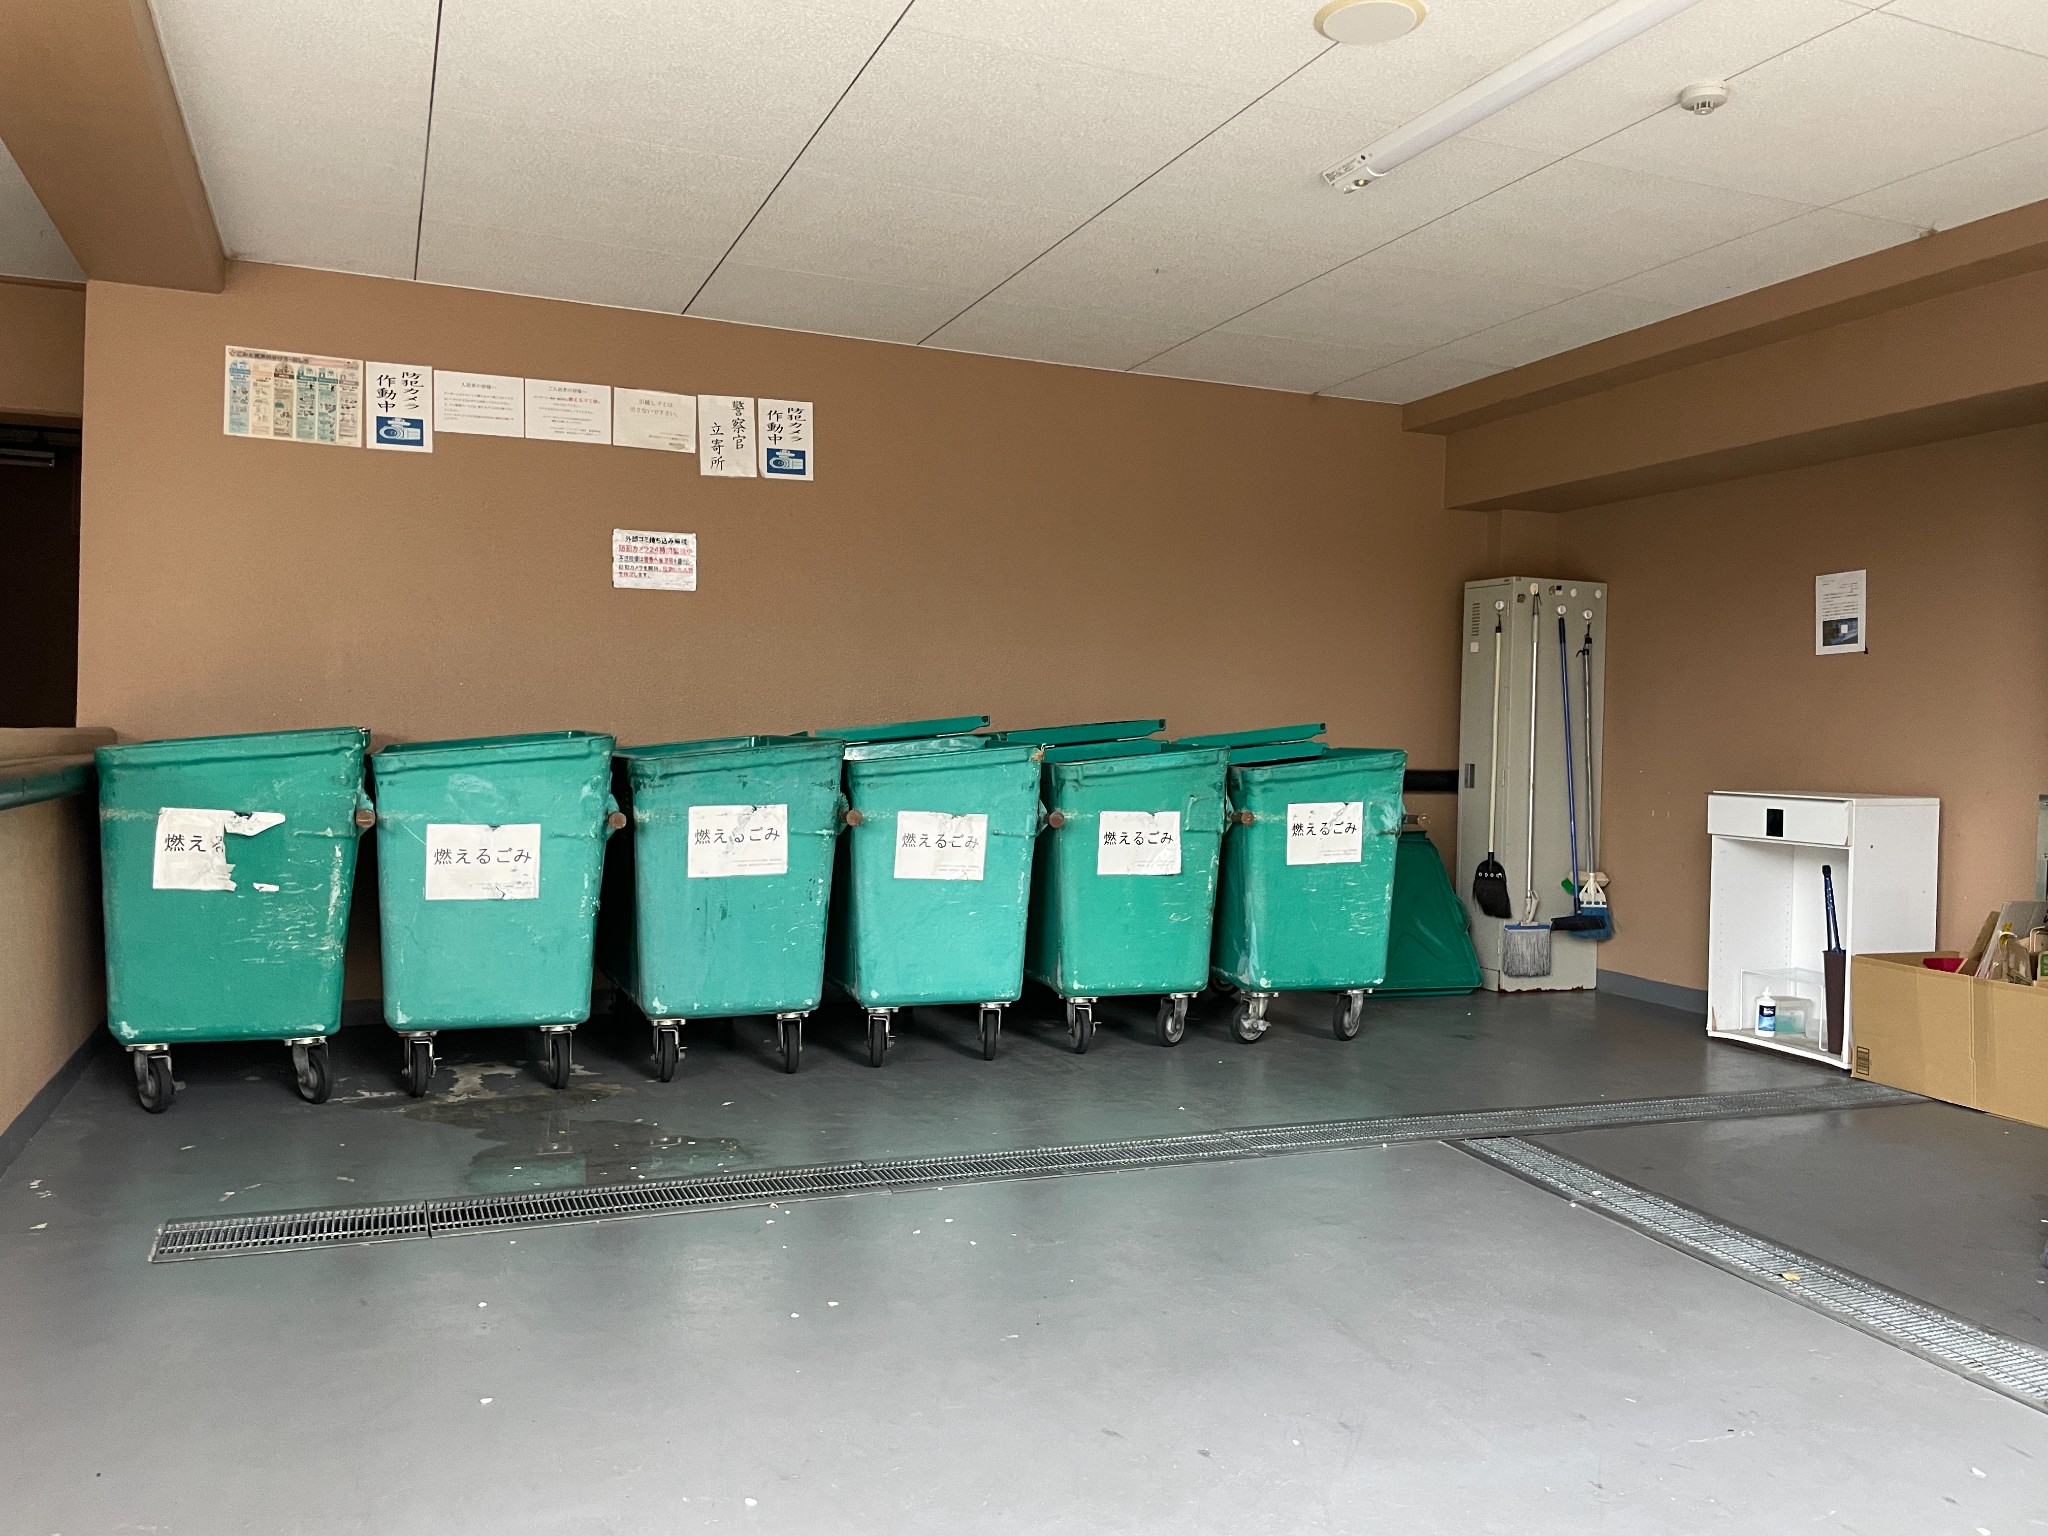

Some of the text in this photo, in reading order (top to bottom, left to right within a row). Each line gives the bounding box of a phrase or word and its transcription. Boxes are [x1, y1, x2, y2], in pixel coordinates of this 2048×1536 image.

[376, 374, 397, 413] 作動中
[401, 372, 424, 410] 防犯カメラ
[732, 400, 747, 450] 警察官
[766, 410, 784, 445] 作動中
[787, 407, 806, 442] 防犯カメラ
[710, 422, 725, 471] 立寄所
[694, 826, 780, 845] 燃えるごみ
[901, 833, 979, 849] 燃えるごみ
[1103, 831, 1174, 845] 燃えるごみ
[1292, 821, 1357, 837] 燃えるごみ
[434, 847, 531, 865] 燃えるごみ
